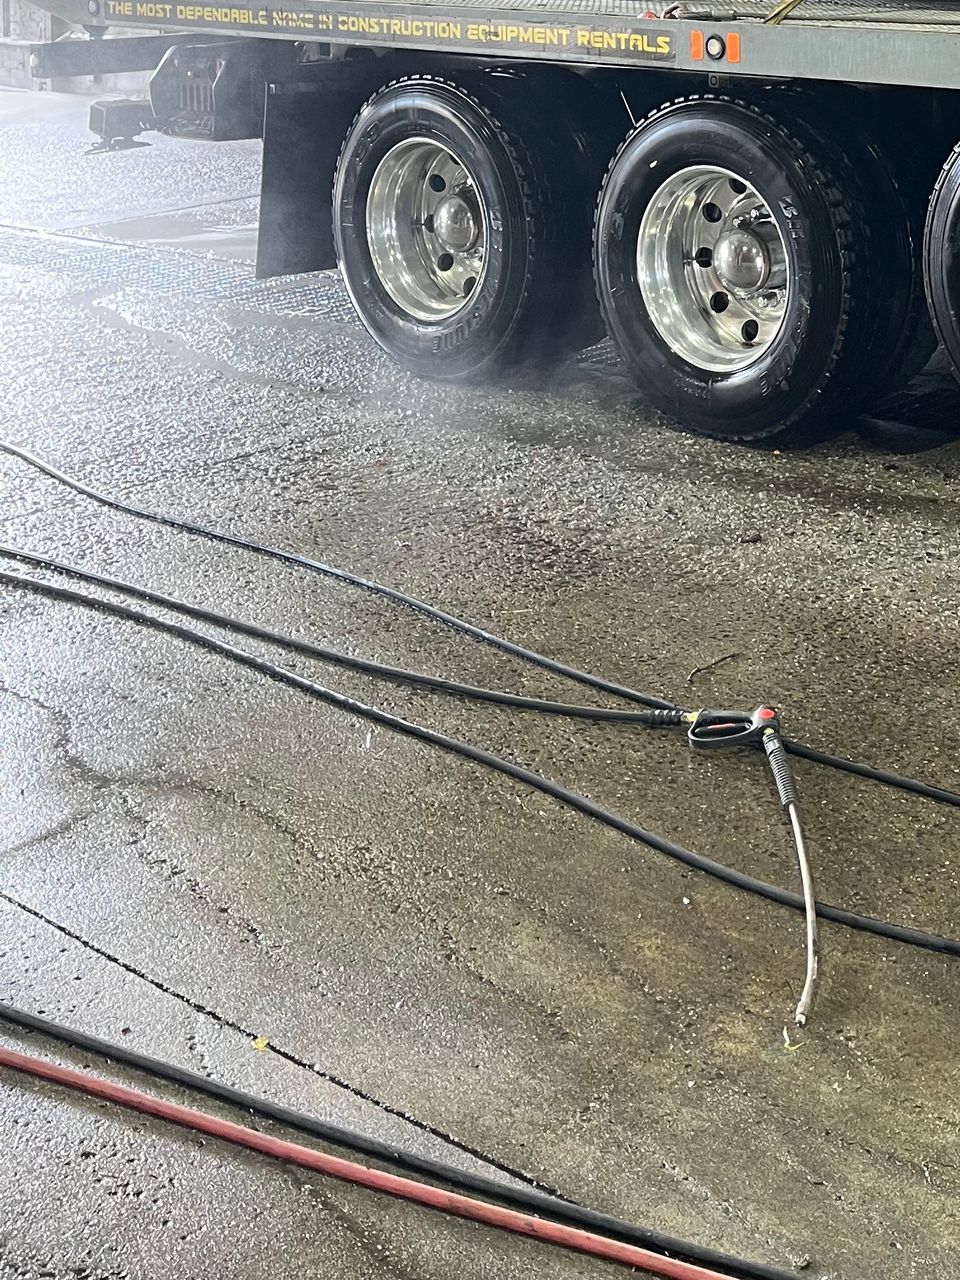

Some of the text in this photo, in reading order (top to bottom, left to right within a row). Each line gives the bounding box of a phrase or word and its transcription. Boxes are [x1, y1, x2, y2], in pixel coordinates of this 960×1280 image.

[107, 0, 671, 54] THE MOST DEPENDABLE NAME IN CONSTRUCTION EQUIPMENT RENTALS
